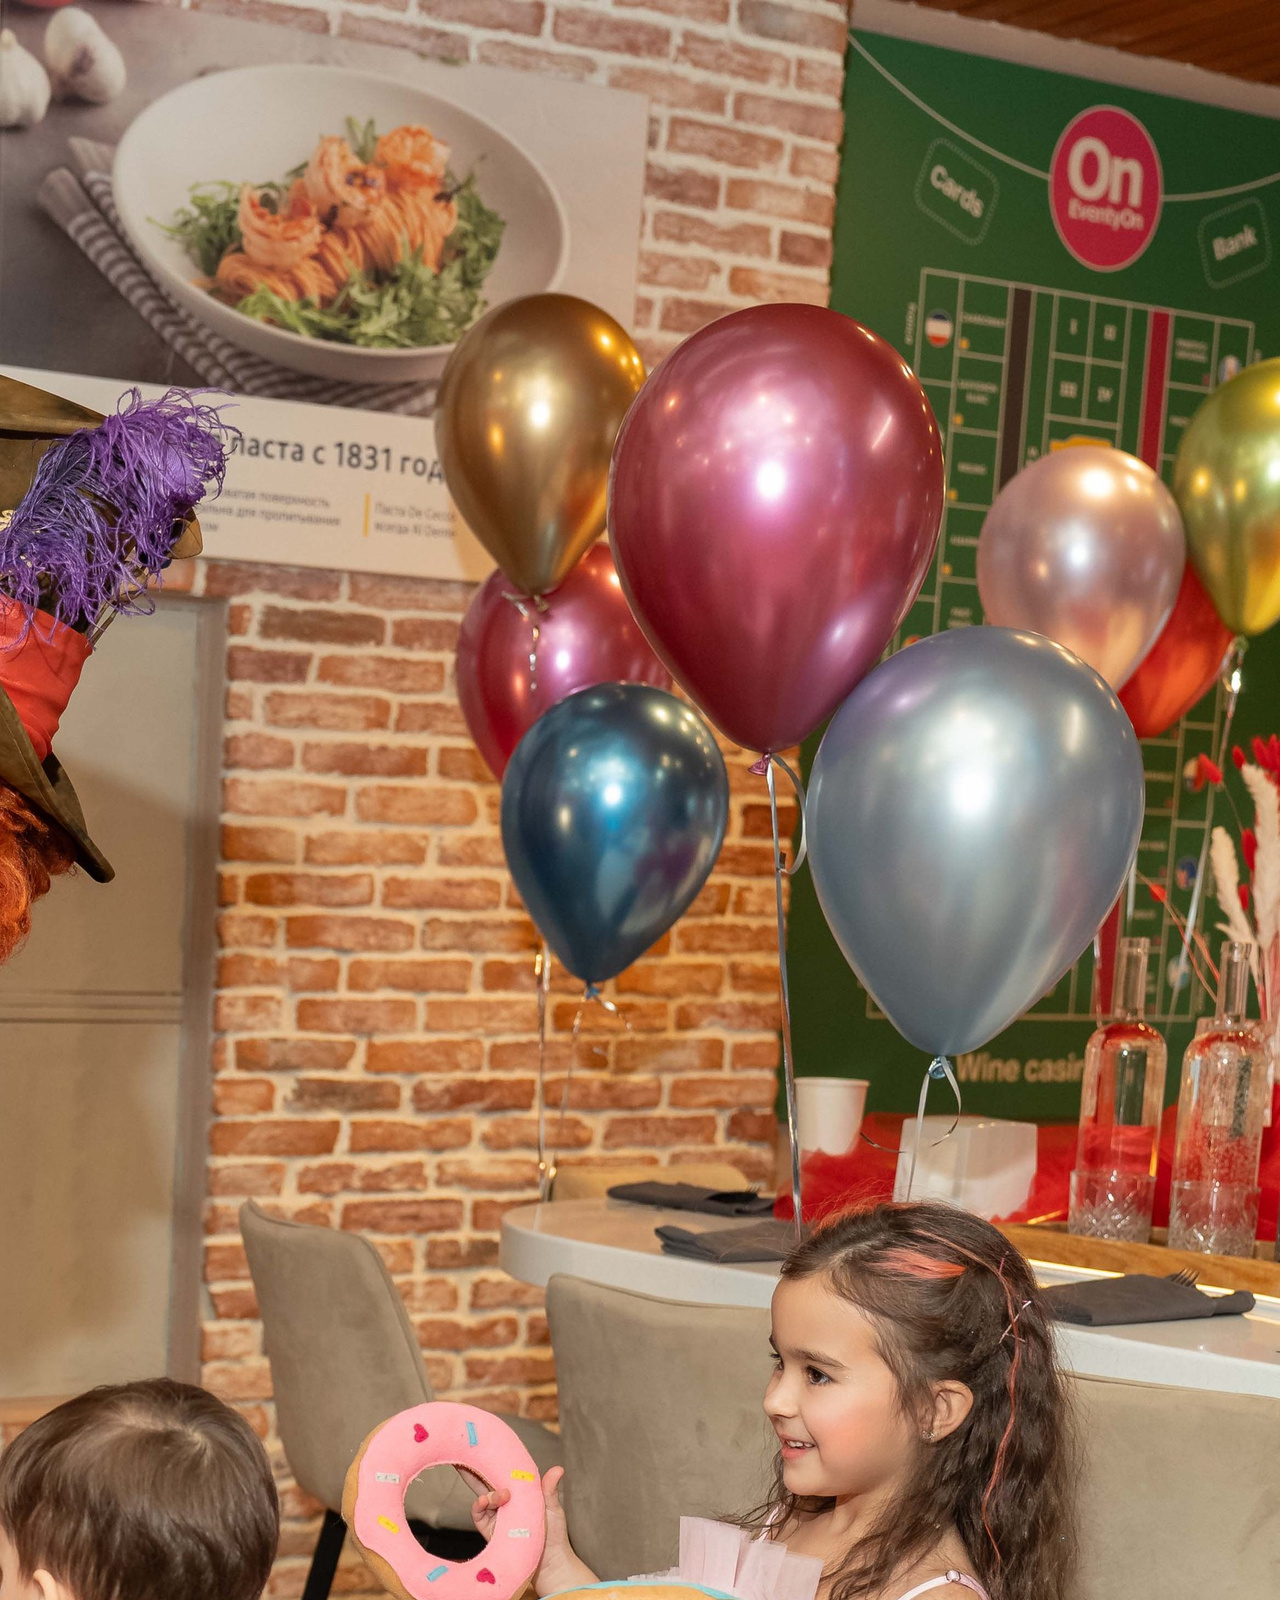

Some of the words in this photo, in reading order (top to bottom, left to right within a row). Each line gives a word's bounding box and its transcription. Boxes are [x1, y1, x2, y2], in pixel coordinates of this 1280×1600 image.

[930, 164, 984, 218] Cards
[1068, 136, 1144, 208] On
[1212, 225, 1258, 261] Bank
[231, 436, 304, 462] паста
[313, 445, 325, 465] с
[334, 441, 391, 472] 1831
[400, 456, 444, 485] год
[956, 1052, 1020, 1083] Wine
